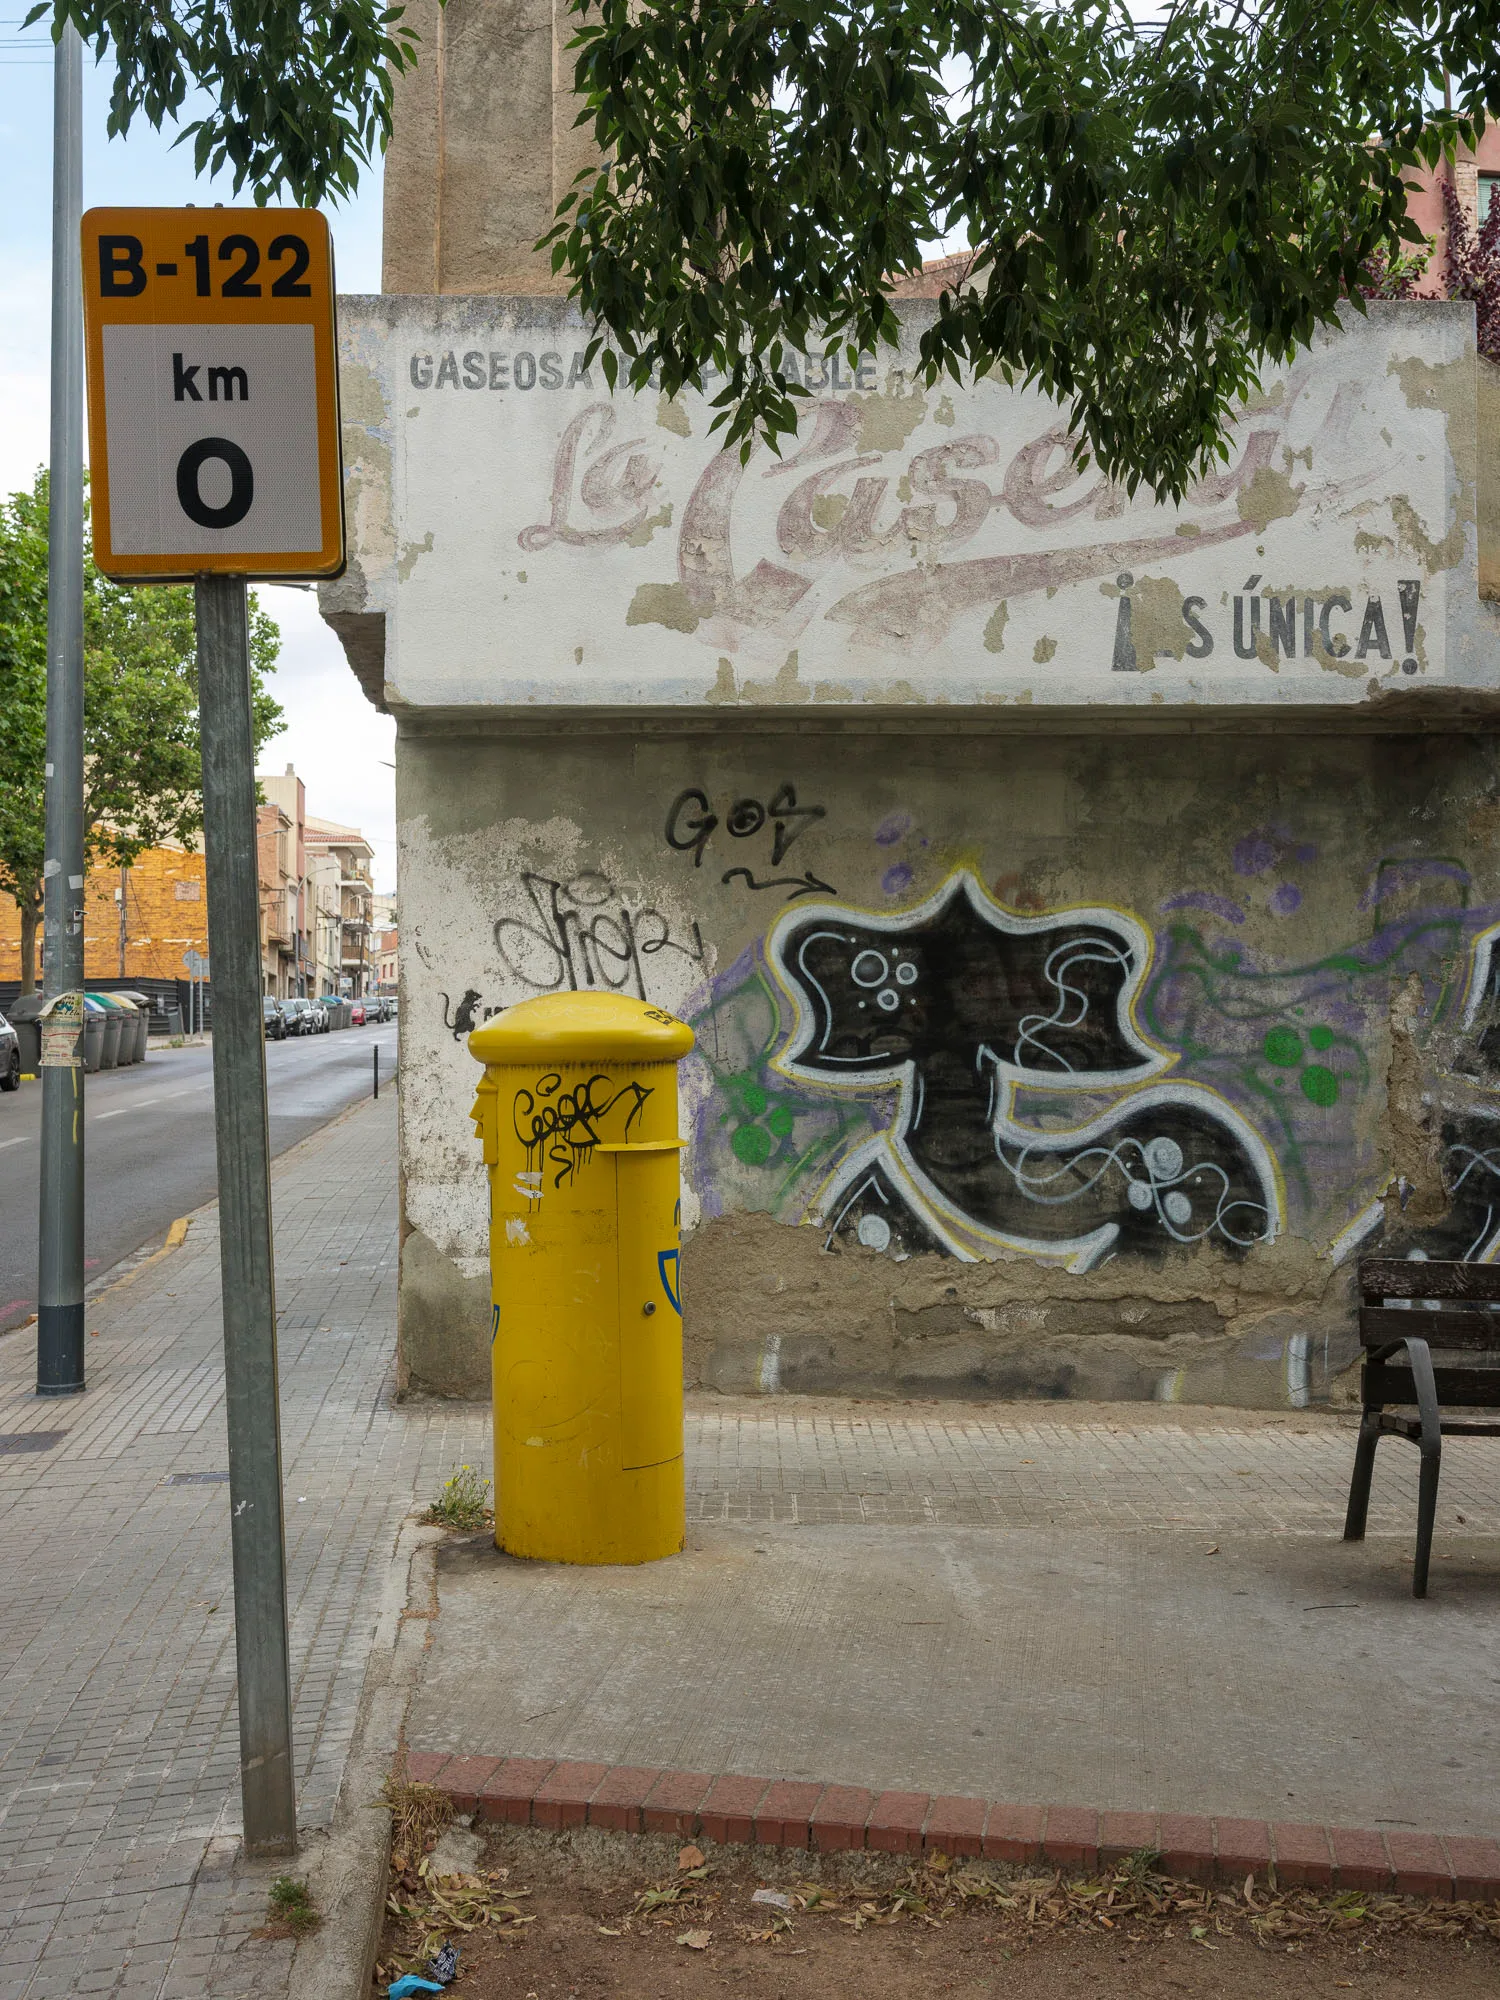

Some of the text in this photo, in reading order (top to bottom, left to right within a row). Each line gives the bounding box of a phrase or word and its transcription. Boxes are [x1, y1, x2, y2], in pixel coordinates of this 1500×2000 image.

[98, 234, 312, 298] B-122
[172, 352, 249, 402] km
[409, 351, 595, 391] GASEOSA
[176, 437, 254, 529] 0
[516, 402, 665, 553] La
[1111, 570, 1421, 675] ¡S ÚNICA!
